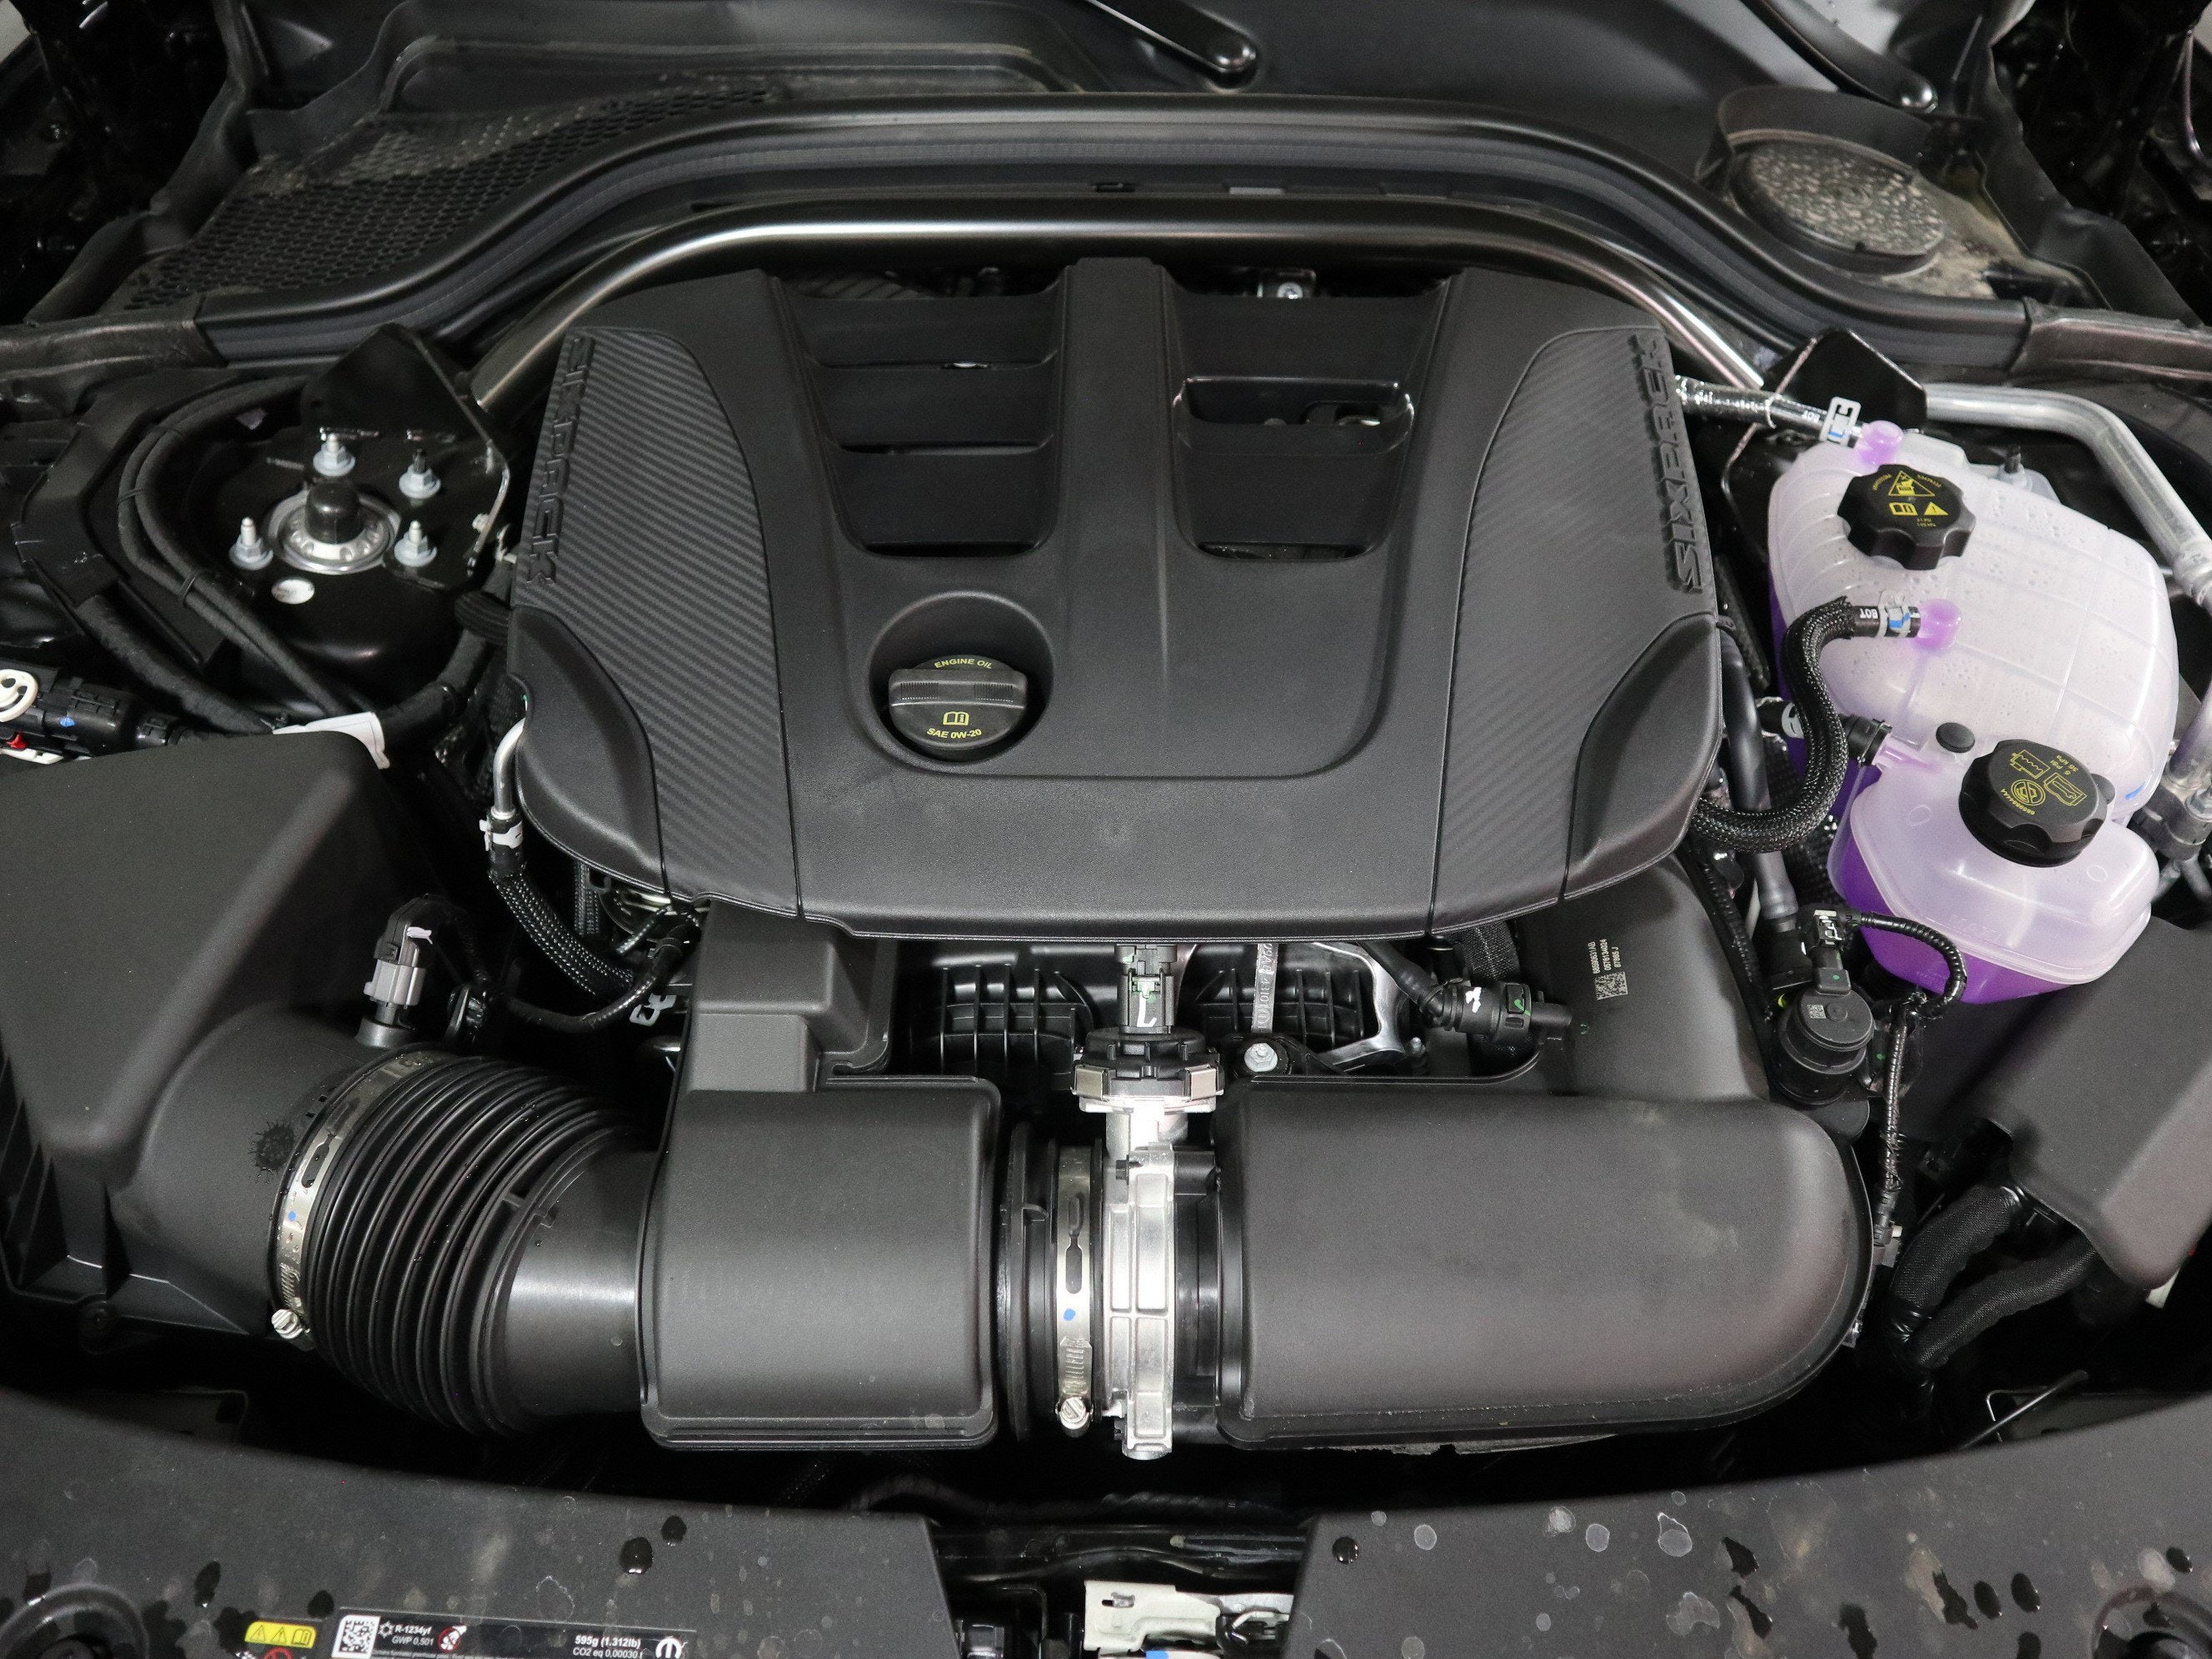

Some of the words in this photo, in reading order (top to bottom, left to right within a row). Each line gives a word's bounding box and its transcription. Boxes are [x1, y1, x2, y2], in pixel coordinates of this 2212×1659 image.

[1628, 335, 1703, 594] SIXPACK
[1860, 608, 1879, 619] BOT
[934, 658, 975, 669] ENGINE
[976, 660, 994, 670] OIL
[926, 727, 948, 738] SAE
[950, 729, 982, 739] 0W-20
[394, 1624, 432, 1637] R-1234yf
[391, 1636, 412, 1645] GWP
[413, 1636, 434, 1647] 0.501
[575, 1634, 599, 1647] 595g
[600, 1636, 641, 1650] (1.312lb)
[572, 1646, 590, 1657] CO2
[592, 1648, 603, 1658] eq
